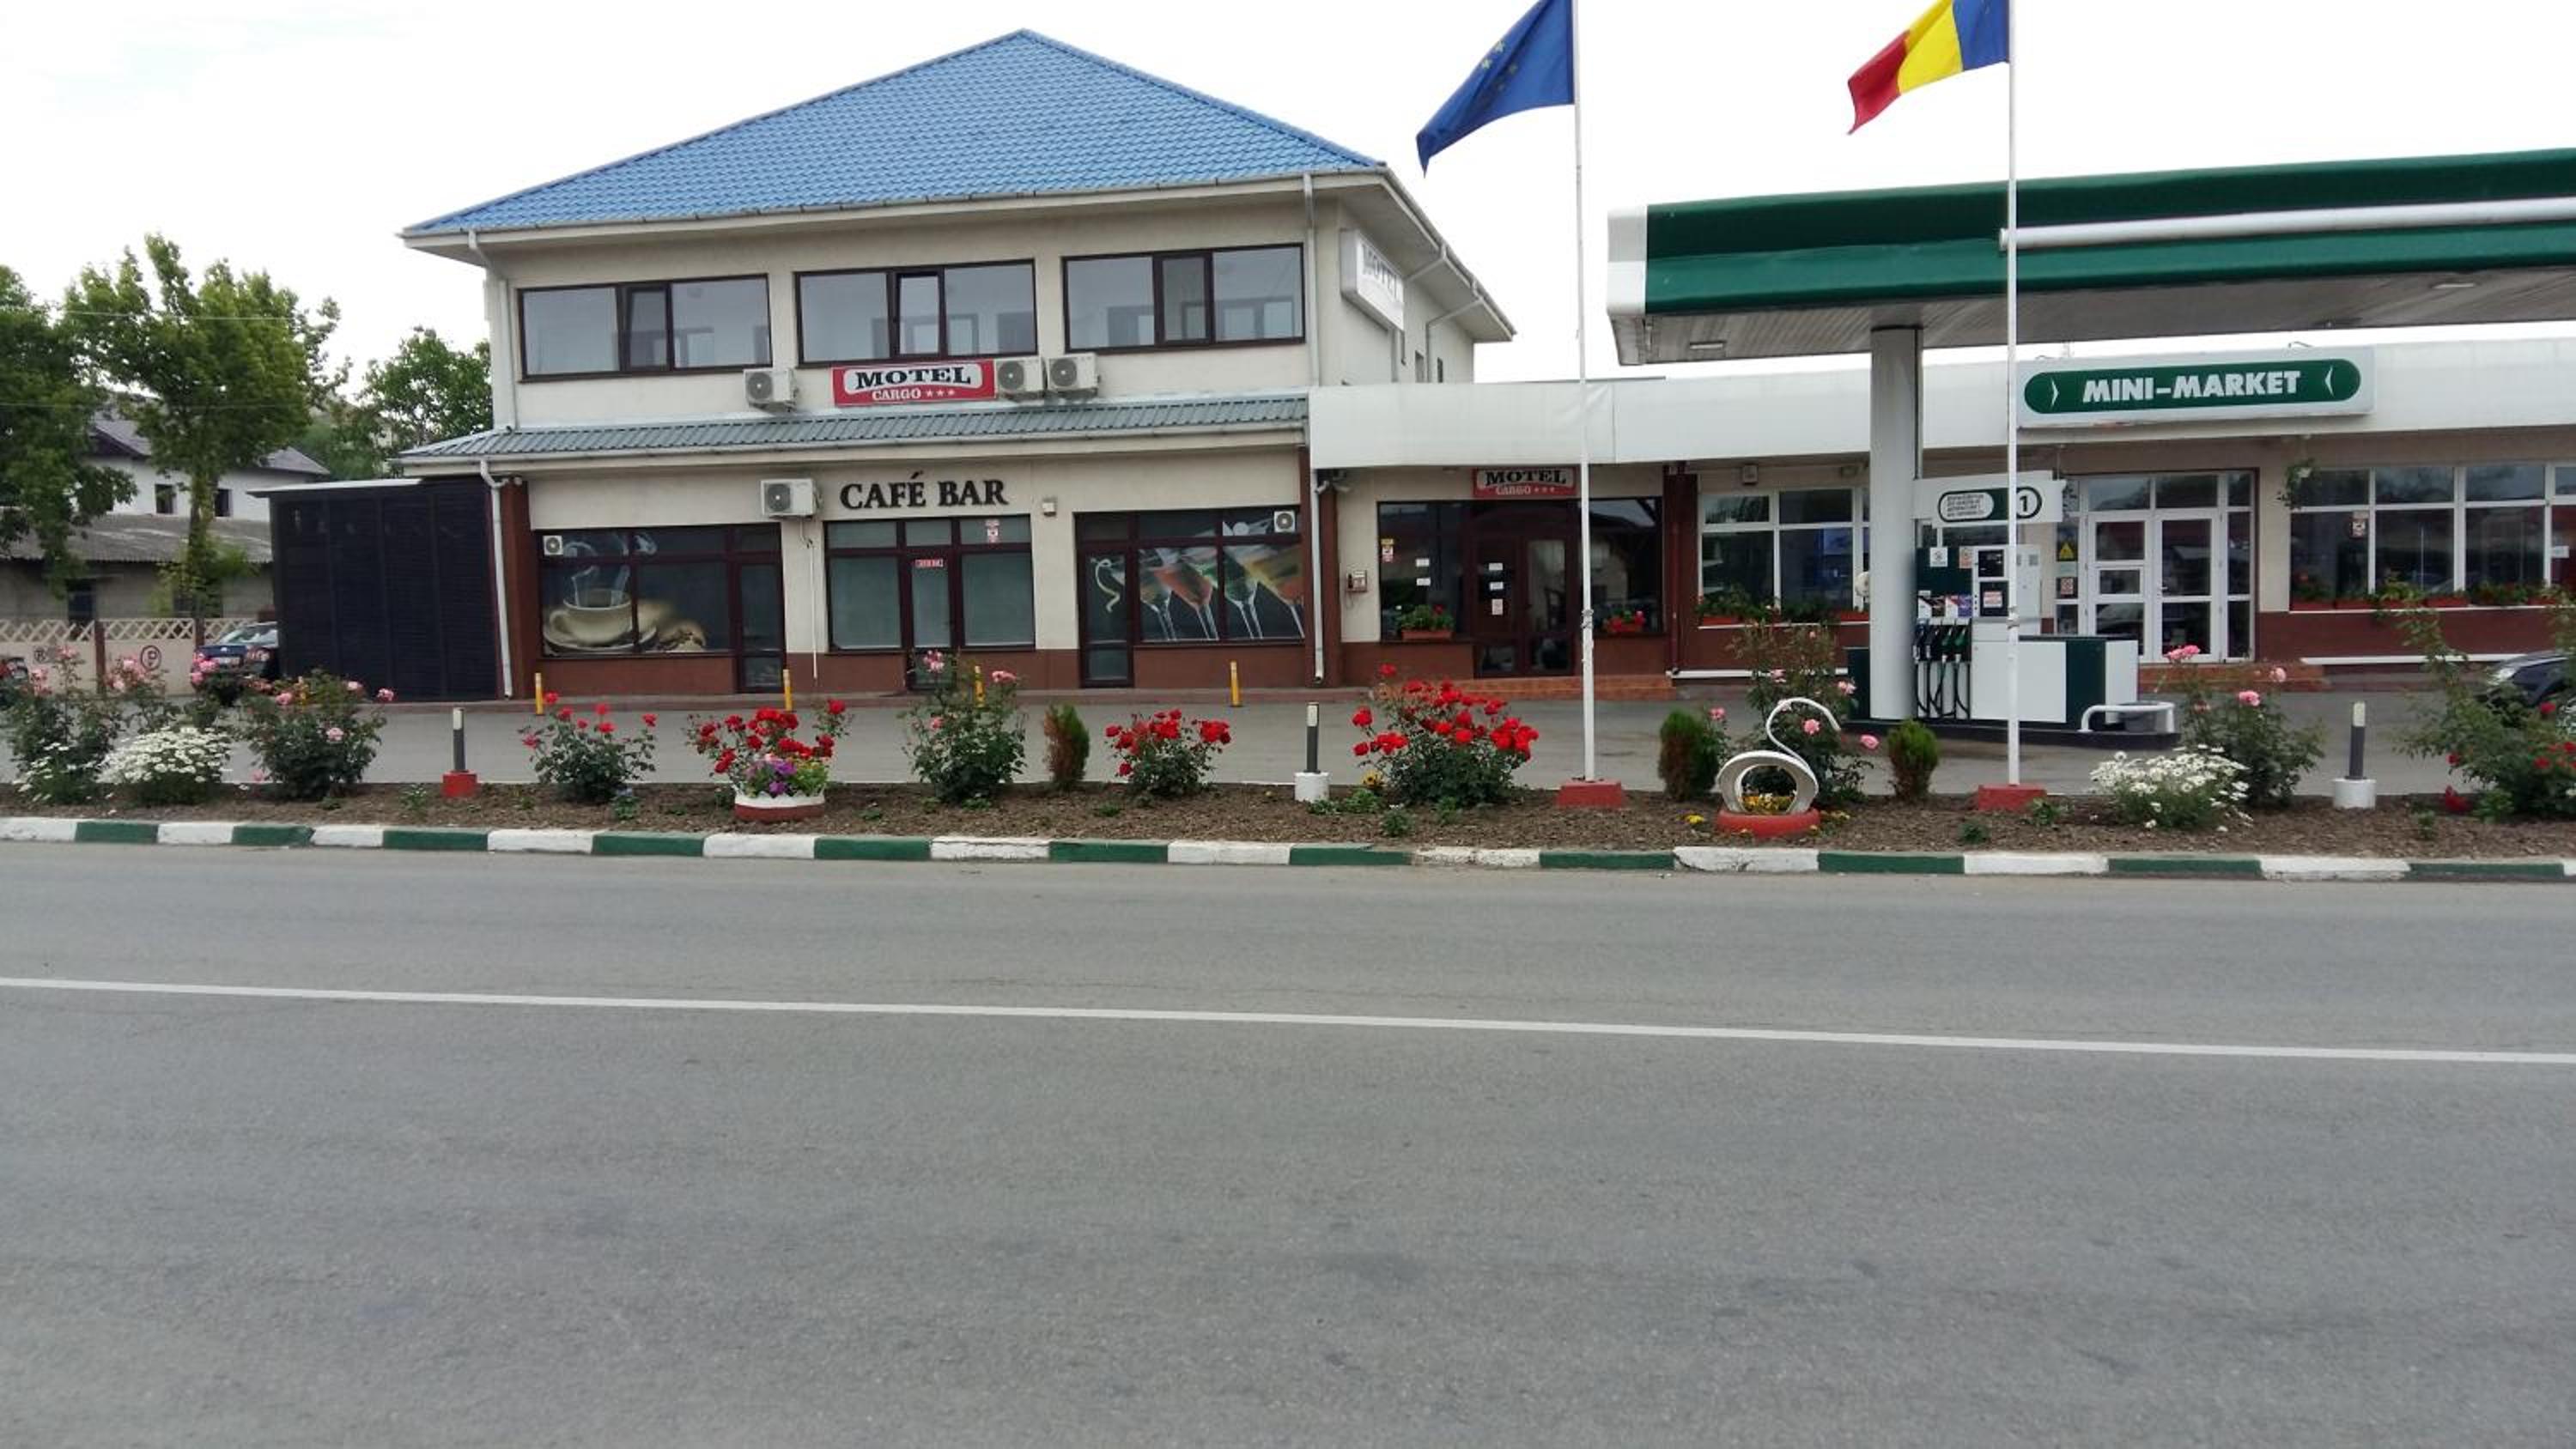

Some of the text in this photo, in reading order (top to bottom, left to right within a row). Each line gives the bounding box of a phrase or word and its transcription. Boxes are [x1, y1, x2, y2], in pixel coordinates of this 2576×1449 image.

[854, 367, 971, 390] MOTEL
[2082, 369, 2301, 404] MINI-MARKET
[872, 389, 921, 401] CARGO
[1485, 470, 1567, 486] MOTEL
[840, 470, 1009, 510] CAFÉ BAR
[1496, 485, 1531, 495] CARGO
[2019, 495, 2028, 512] 1
